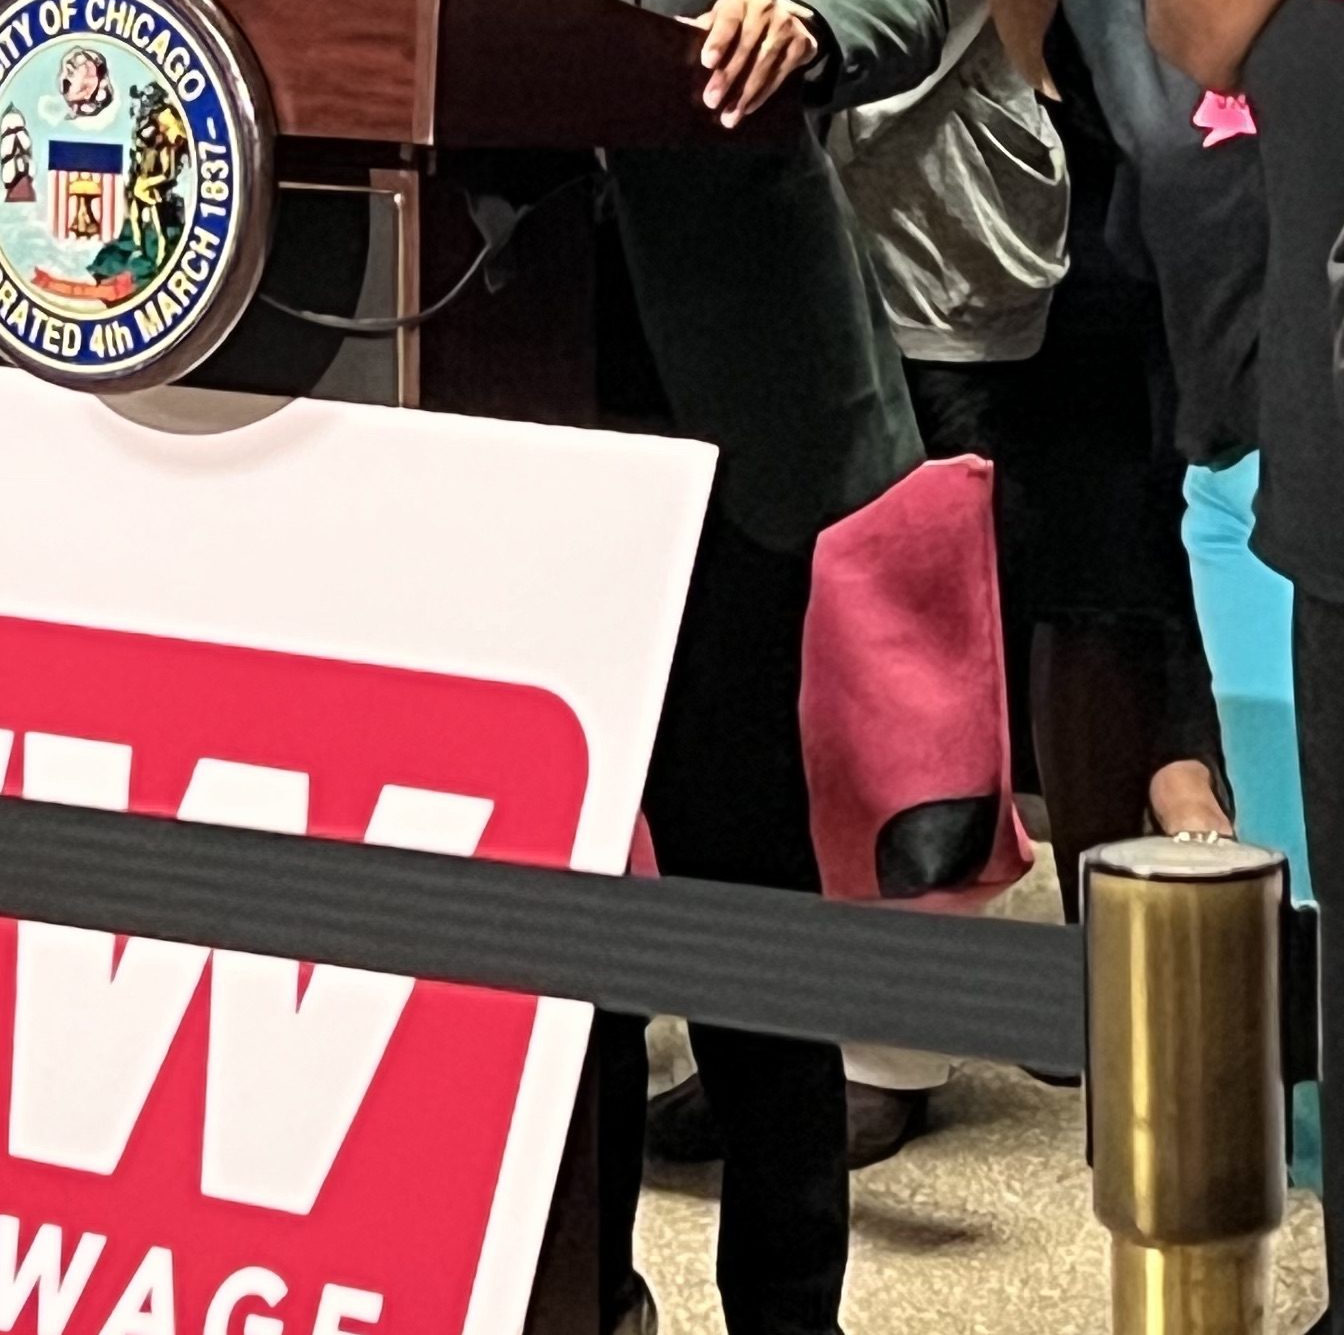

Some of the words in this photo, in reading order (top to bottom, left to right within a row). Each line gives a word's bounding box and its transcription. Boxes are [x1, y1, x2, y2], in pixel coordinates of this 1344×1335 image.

[90, 323, 134, 358] 4th
[134, 226, 220, 344] MARCH
[198, 141, 229, 219] 1837
